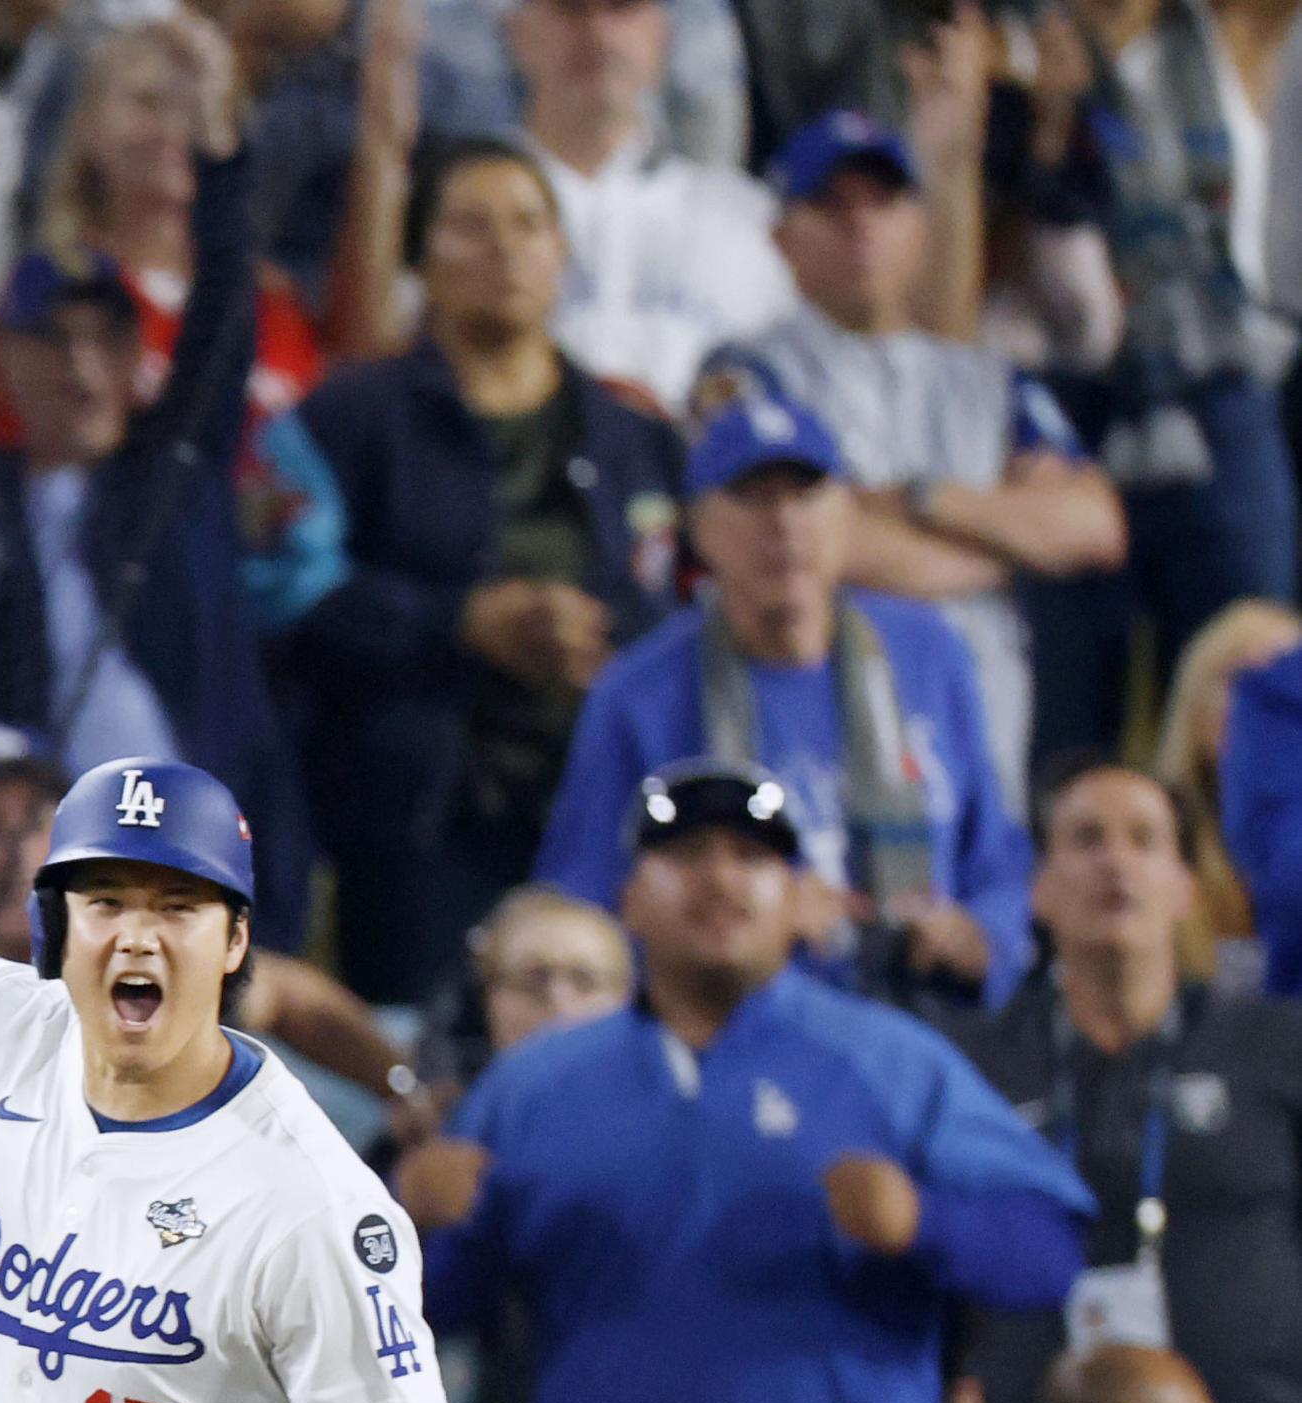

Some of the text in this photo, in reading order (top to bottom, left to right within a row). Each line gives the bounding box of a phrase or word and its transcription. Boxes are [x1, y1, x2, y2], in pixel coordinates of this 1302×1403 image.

[115, 769, 166, 827] LA
[362, 1233, 395, 1265] 34
[366, 1284, 422, 1378] LA
